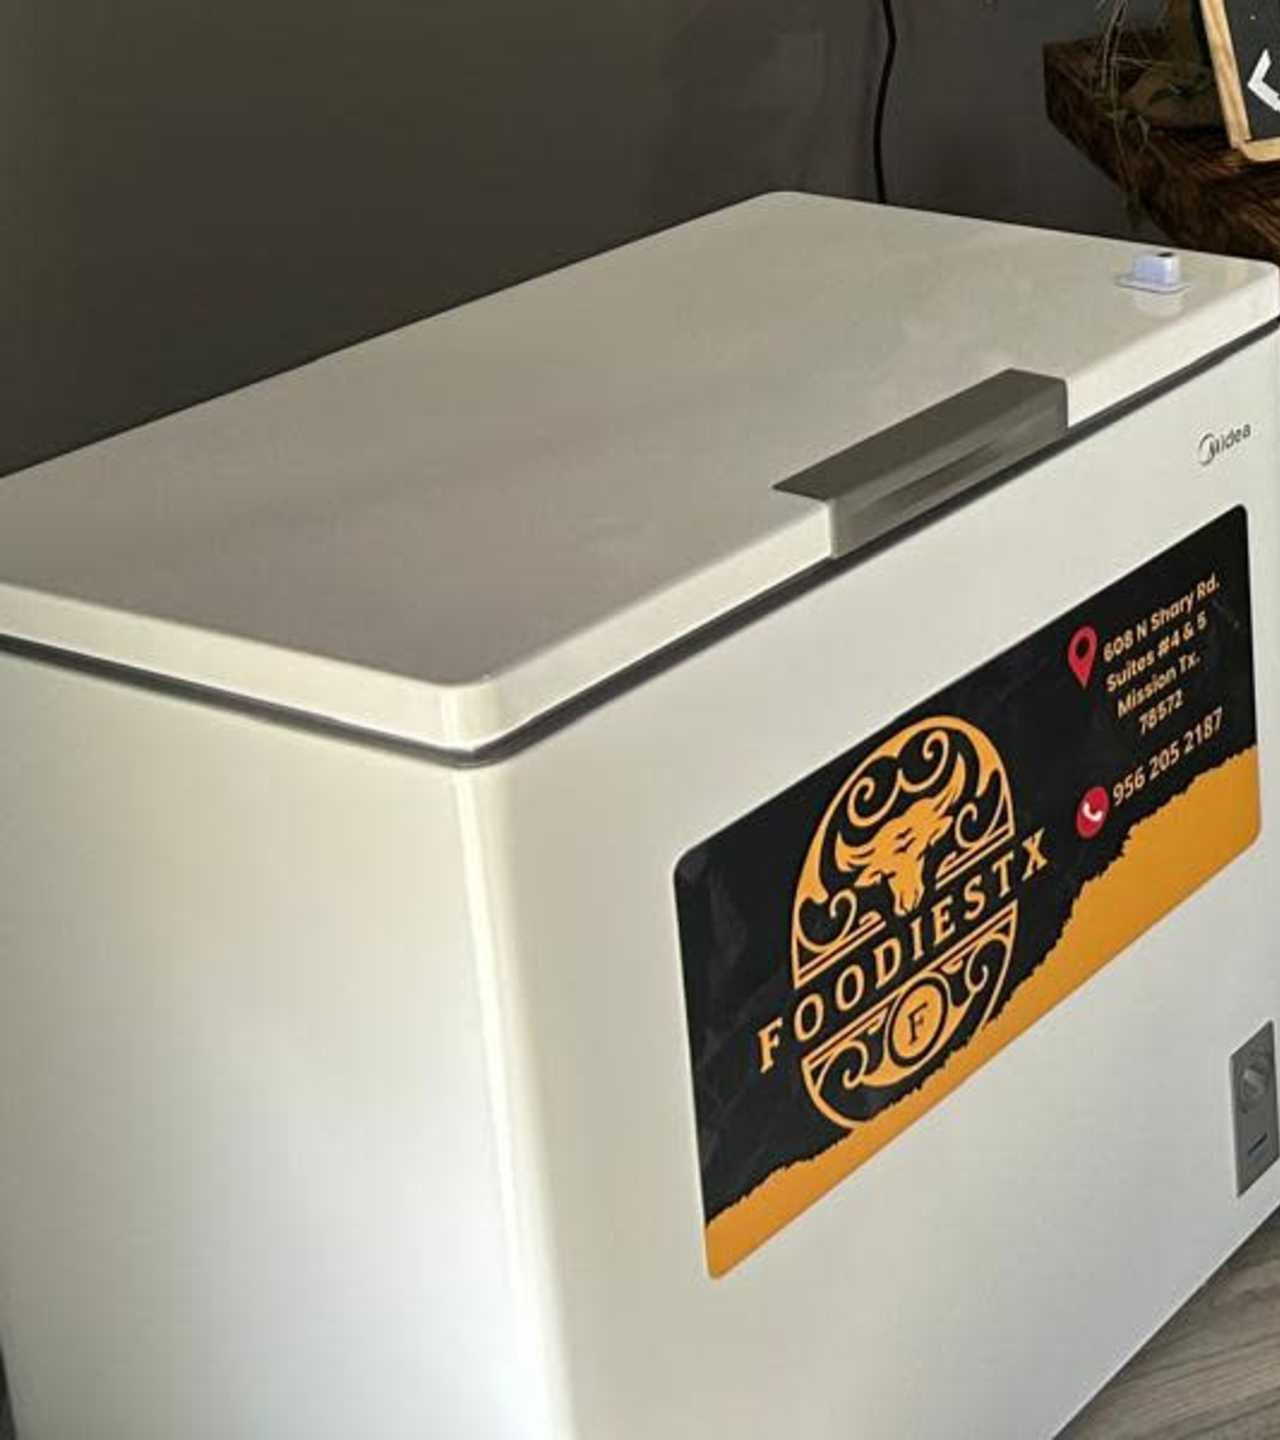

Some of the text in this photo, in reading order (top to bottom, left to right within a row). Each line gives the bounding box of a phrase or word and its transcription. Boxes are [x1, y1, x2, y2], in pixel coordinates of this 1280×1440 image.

[1199, 423, 1251, 466] Midea
[1103, 571, 1220, 662] 608 N Shary Rd.
[1106, 610, 1207, 692] Suites #4 & 5
[1117, 650, 1201, 718] Mission Tx.
[1138, 688, 1184, 736] 78572
[1113, 706, 1223, 807] 956 205 2187
[757, 827, 1049, 1074] FOODIESTX
[908, 1001, 929, 1046] F
